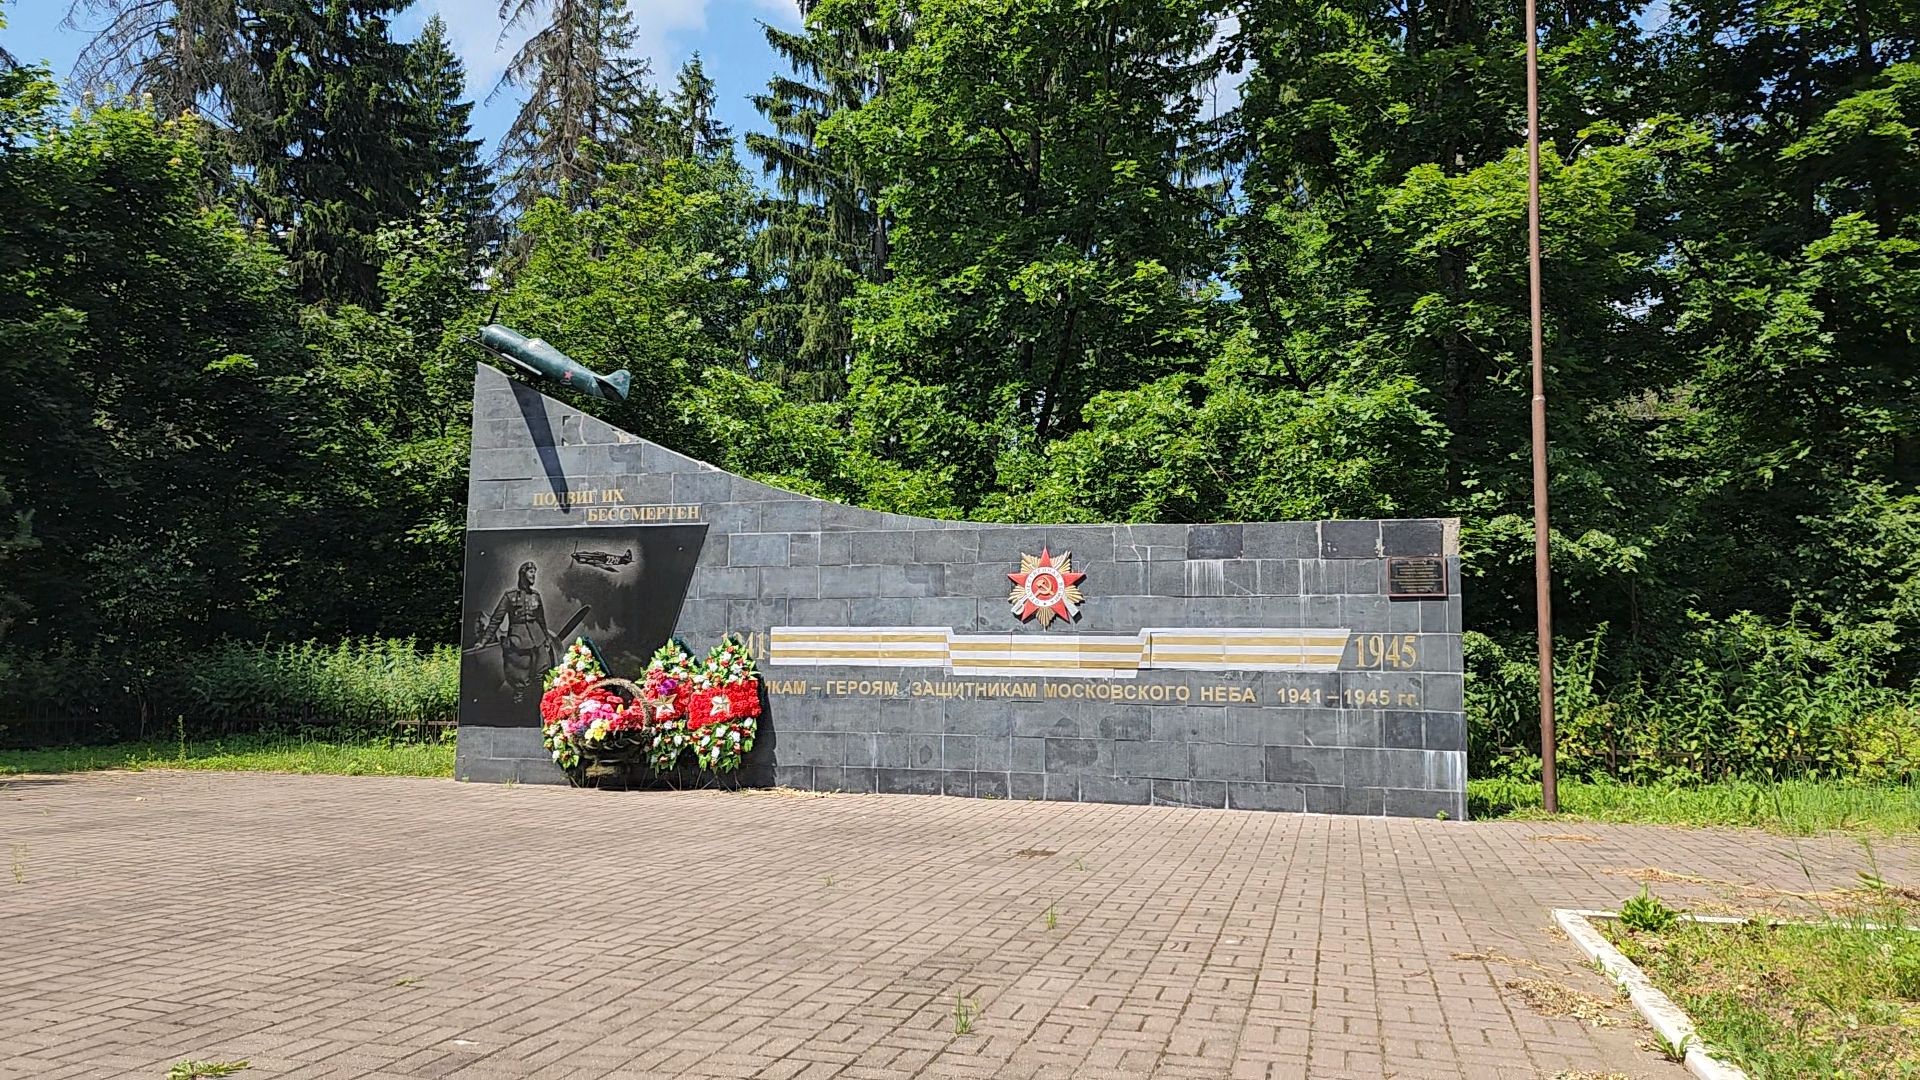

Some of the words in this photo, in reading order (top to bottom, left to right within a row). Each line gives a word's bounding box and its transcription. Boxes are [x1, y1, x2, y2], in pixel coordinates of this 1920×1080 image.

[532, 491, 597, 510] ПОДВИГ
[602, 489, 624, 503] ИХ
[587, 506, 699, 522] БЕССМЕРТЕН
[1354, 635, 1417, 668] 1945
[826, 680, 898, 696] ГЕРОЯМ
[912, 681, 1037, 699] ЗАЩИТНИКАМ
[1043, 683, 1190, 702] МОСКОВСКОГО
[1200, 686, 1256, 702] НЕБА
[1277, 688, 1322, 704] 1941
[1344, 689, 1390, 706] 1945
